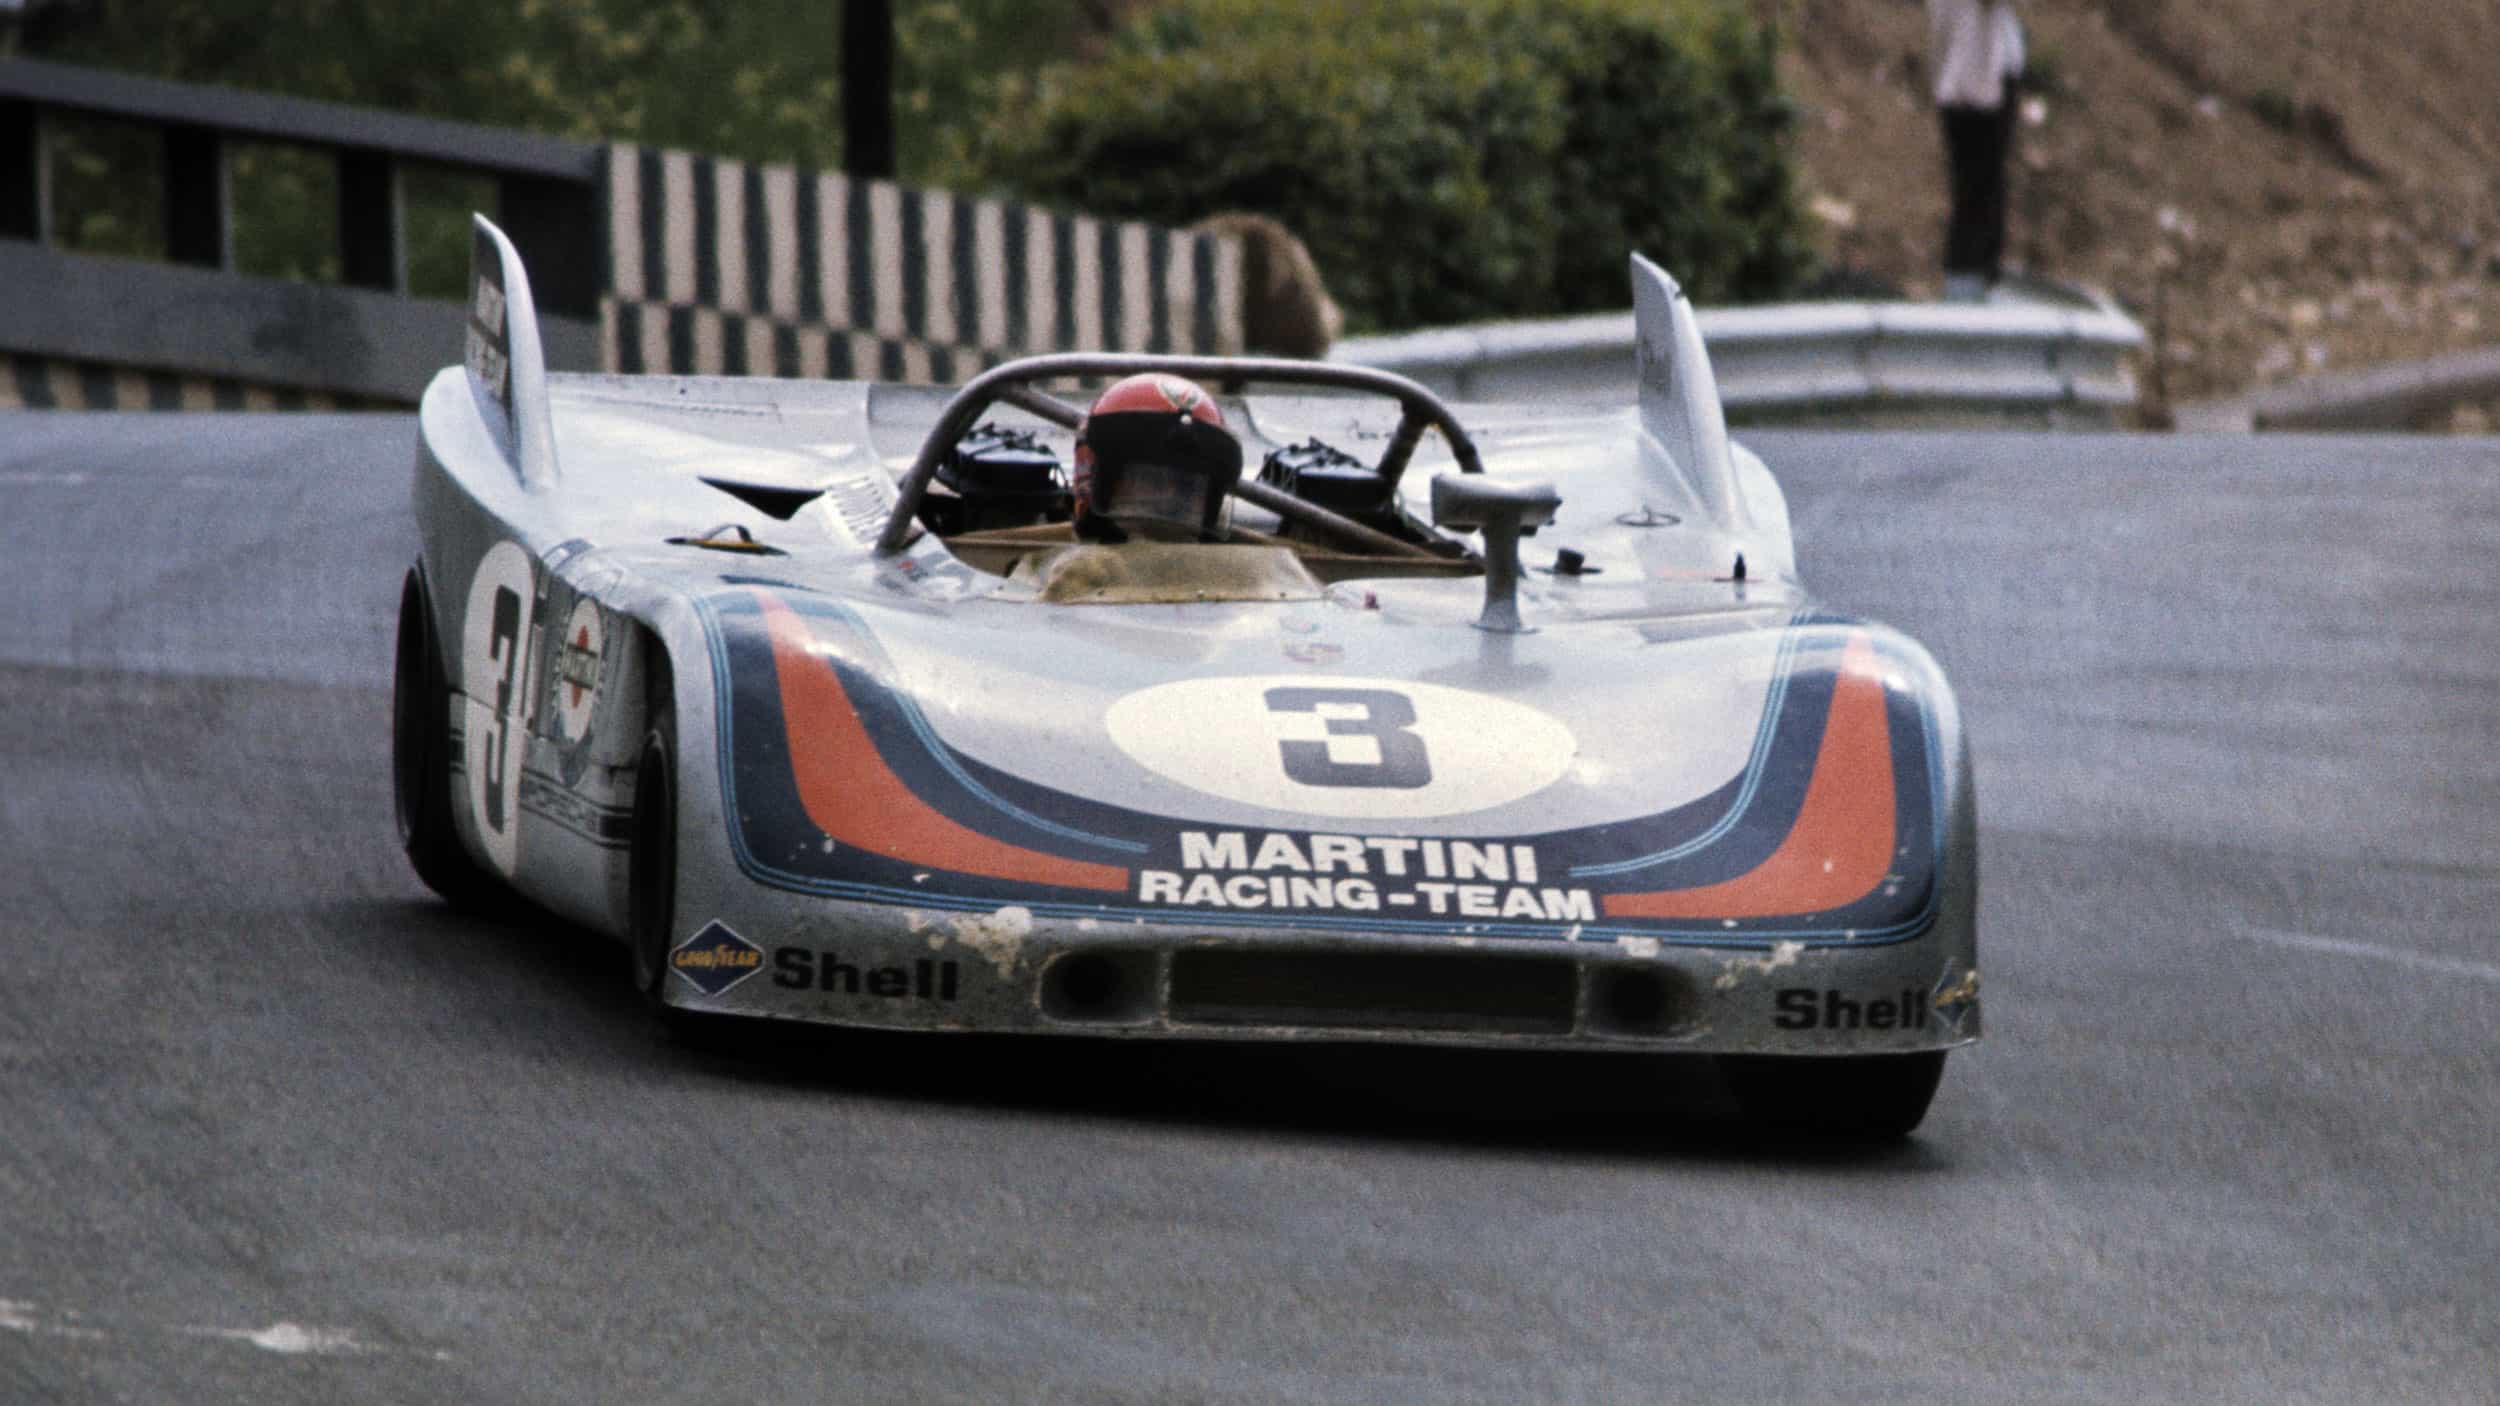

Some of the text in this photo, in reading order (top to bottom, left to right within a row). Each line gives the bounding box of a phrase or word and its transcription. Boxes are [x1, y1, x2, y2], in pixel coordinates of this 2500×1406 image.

[485, 583, 521, 836] 3
[1263, 687, 1432, 790] 3
[1179, 832, 1538, 883] MARTINI
[772, 947, 958, 1002] Shell
[1773, 988, 1927, 1030] Shell
